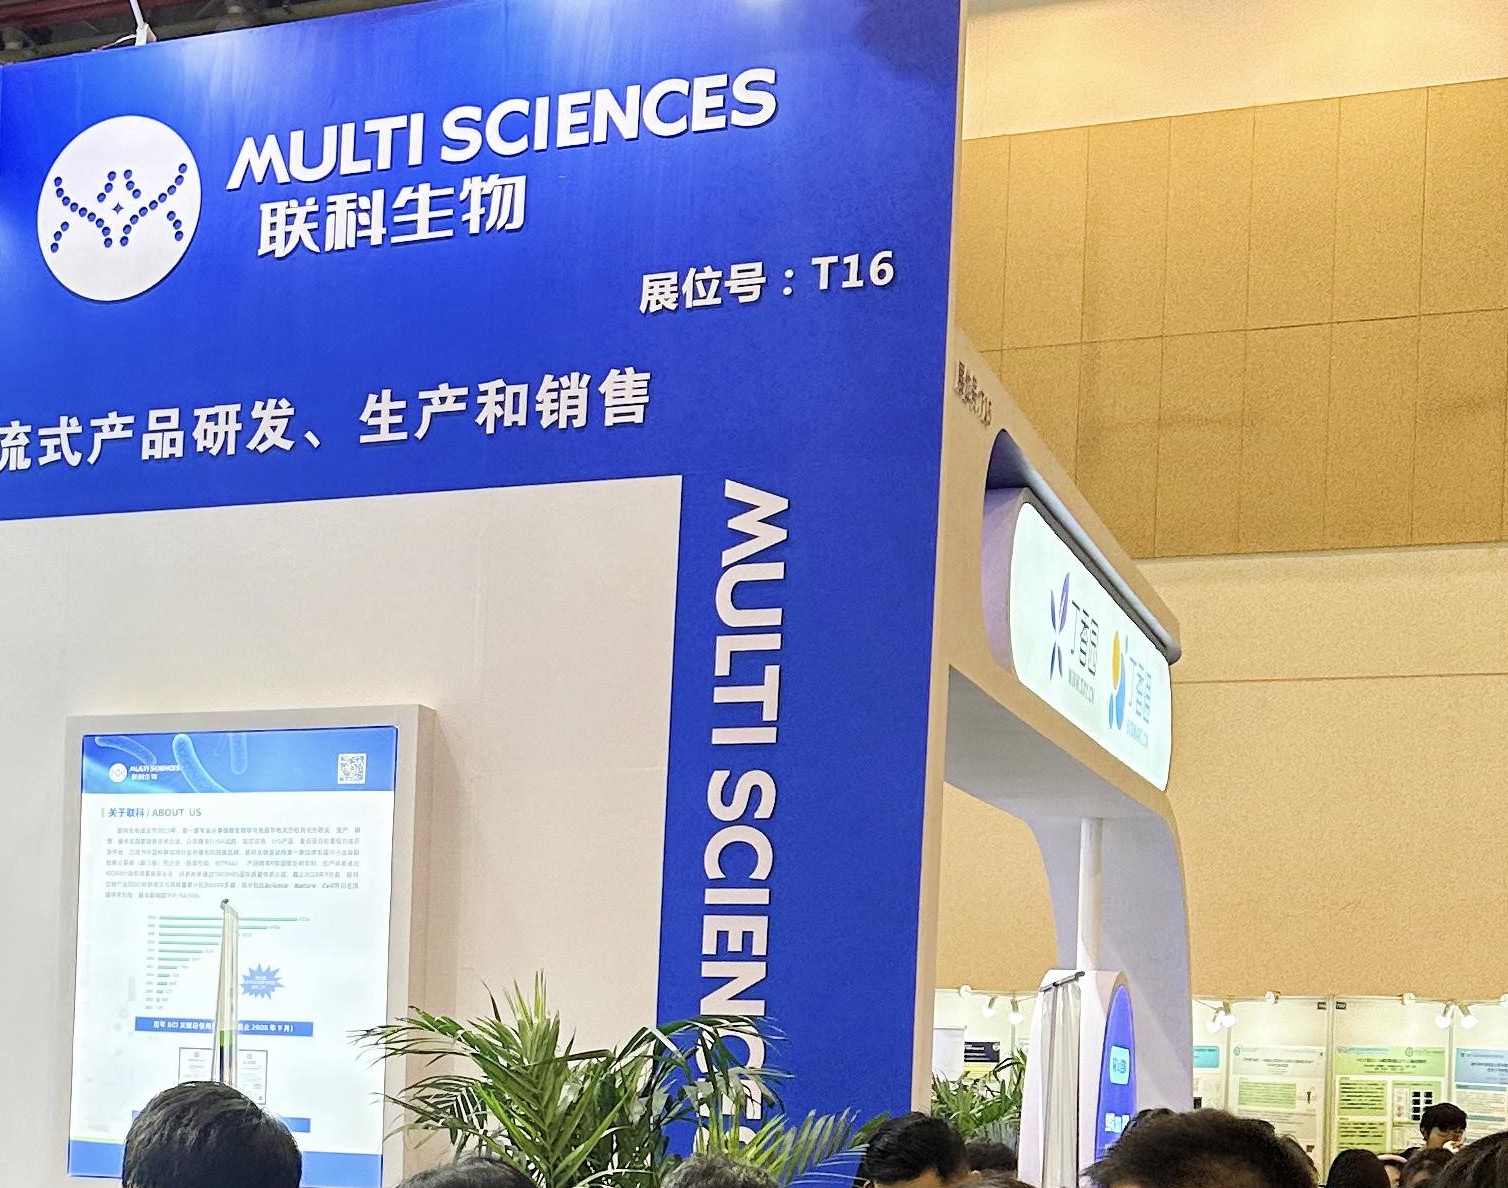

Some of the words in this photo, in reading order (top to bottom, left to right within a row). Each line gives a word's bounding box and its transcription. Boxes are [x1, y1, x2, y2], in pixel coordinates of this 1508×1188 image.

[225, 110, 425, 190] MULTI
[439, 67, 779, 165] SCIENCES
[257, 173, 528, 259] 联科生物
[710, 477, 791, 746] MULTI
[152, 808, 185, 817] ABOUT
[189, 808, 202, 817] US
